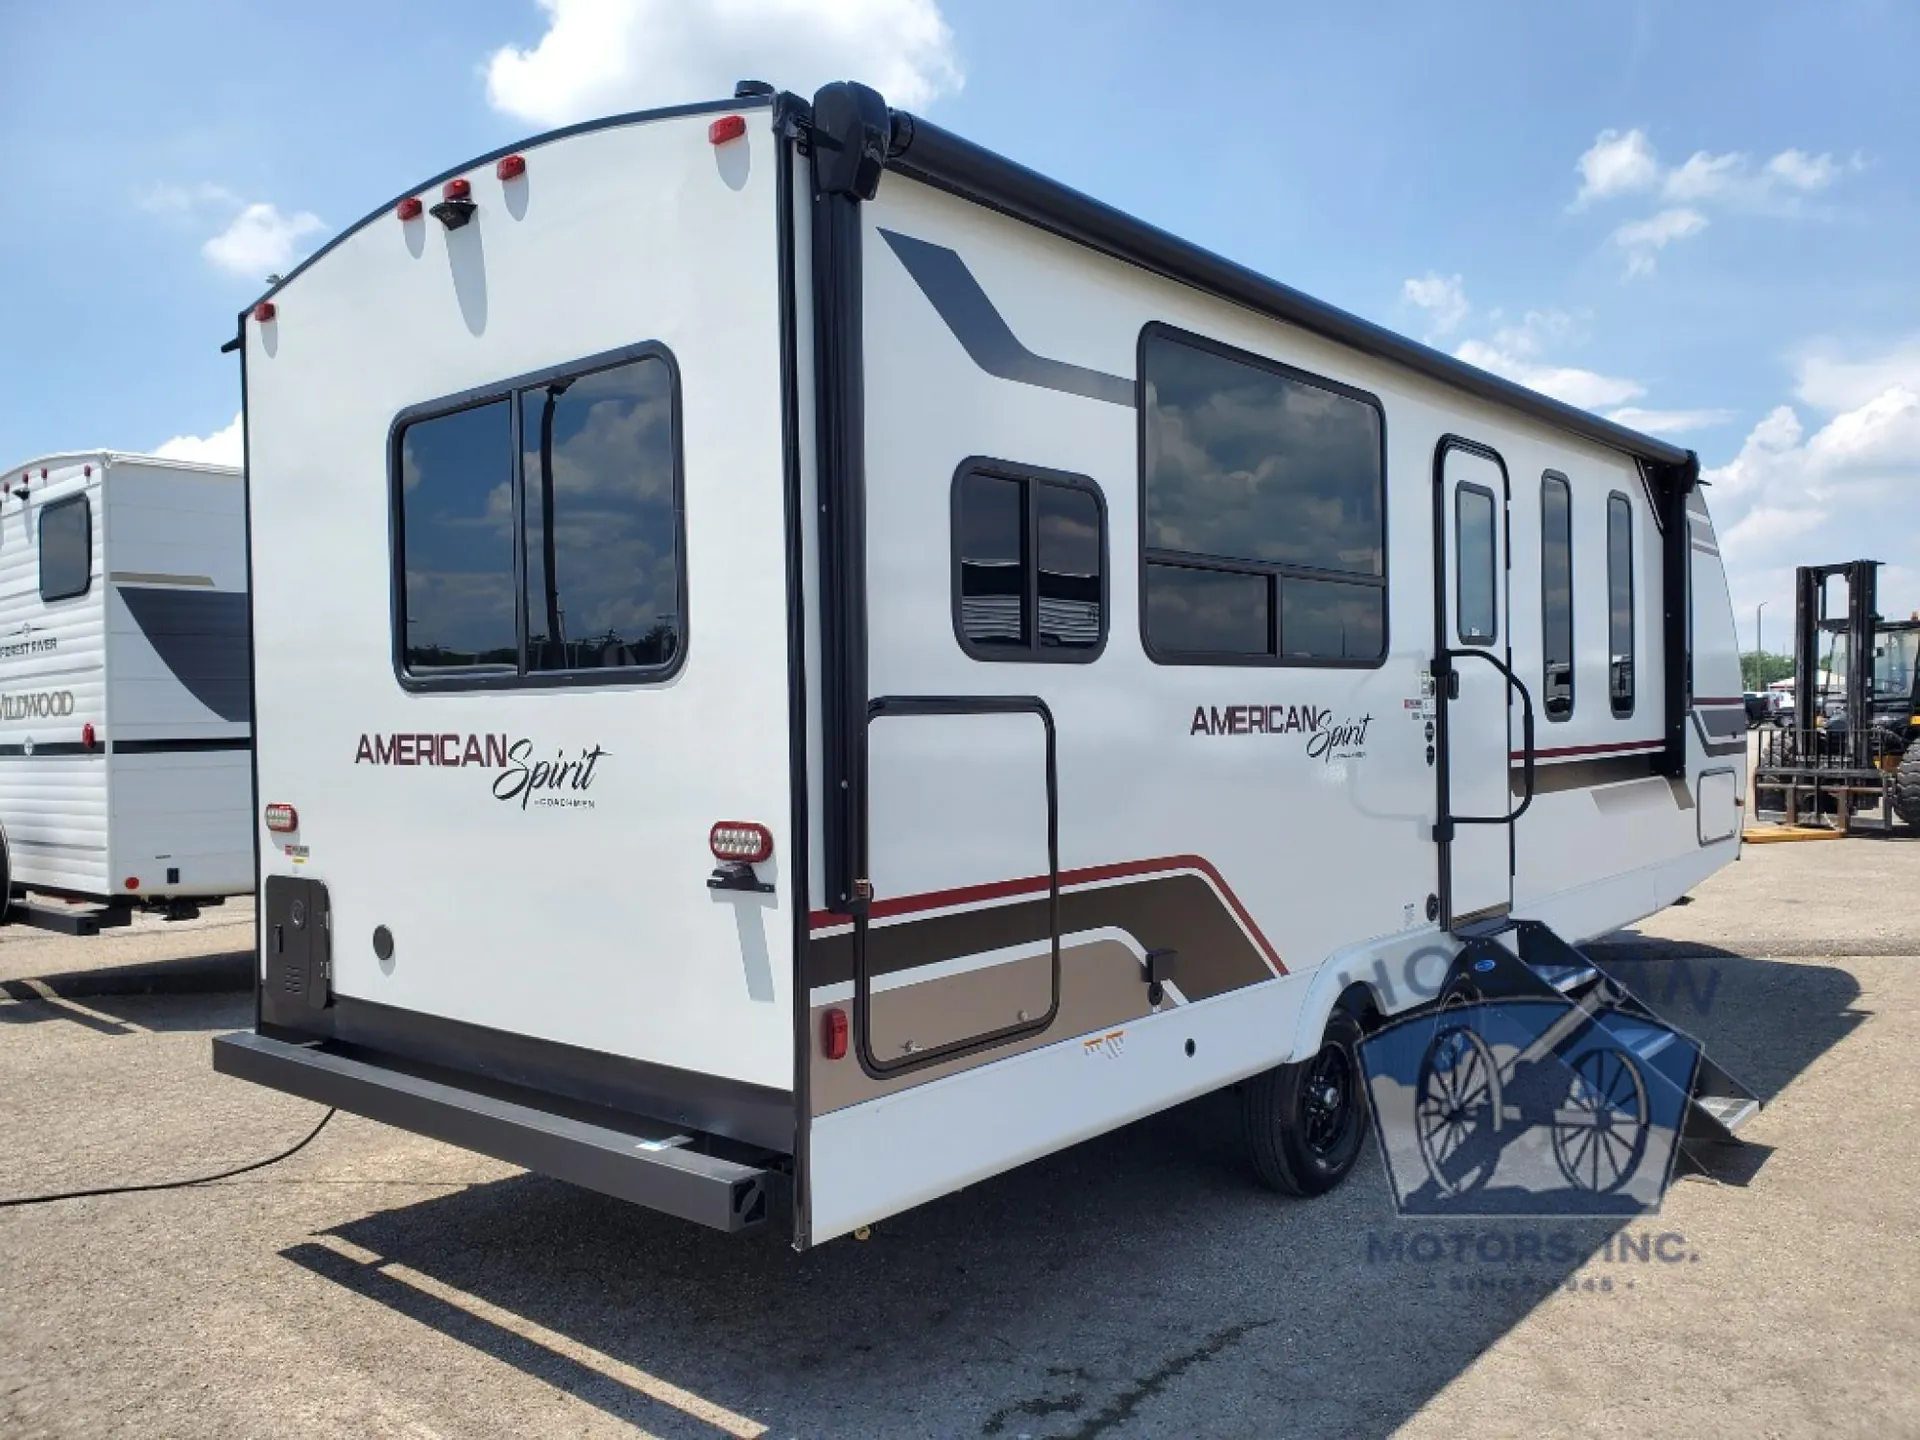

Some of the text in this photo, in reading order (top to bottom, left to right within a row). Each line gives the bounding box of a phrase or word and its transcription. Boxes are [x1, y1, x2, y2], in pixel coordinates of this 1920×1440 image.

[1190, 705, 1375, 764] AMERICAN Spirit
[355, 733, 613, 810] AMERICAN Spirit
